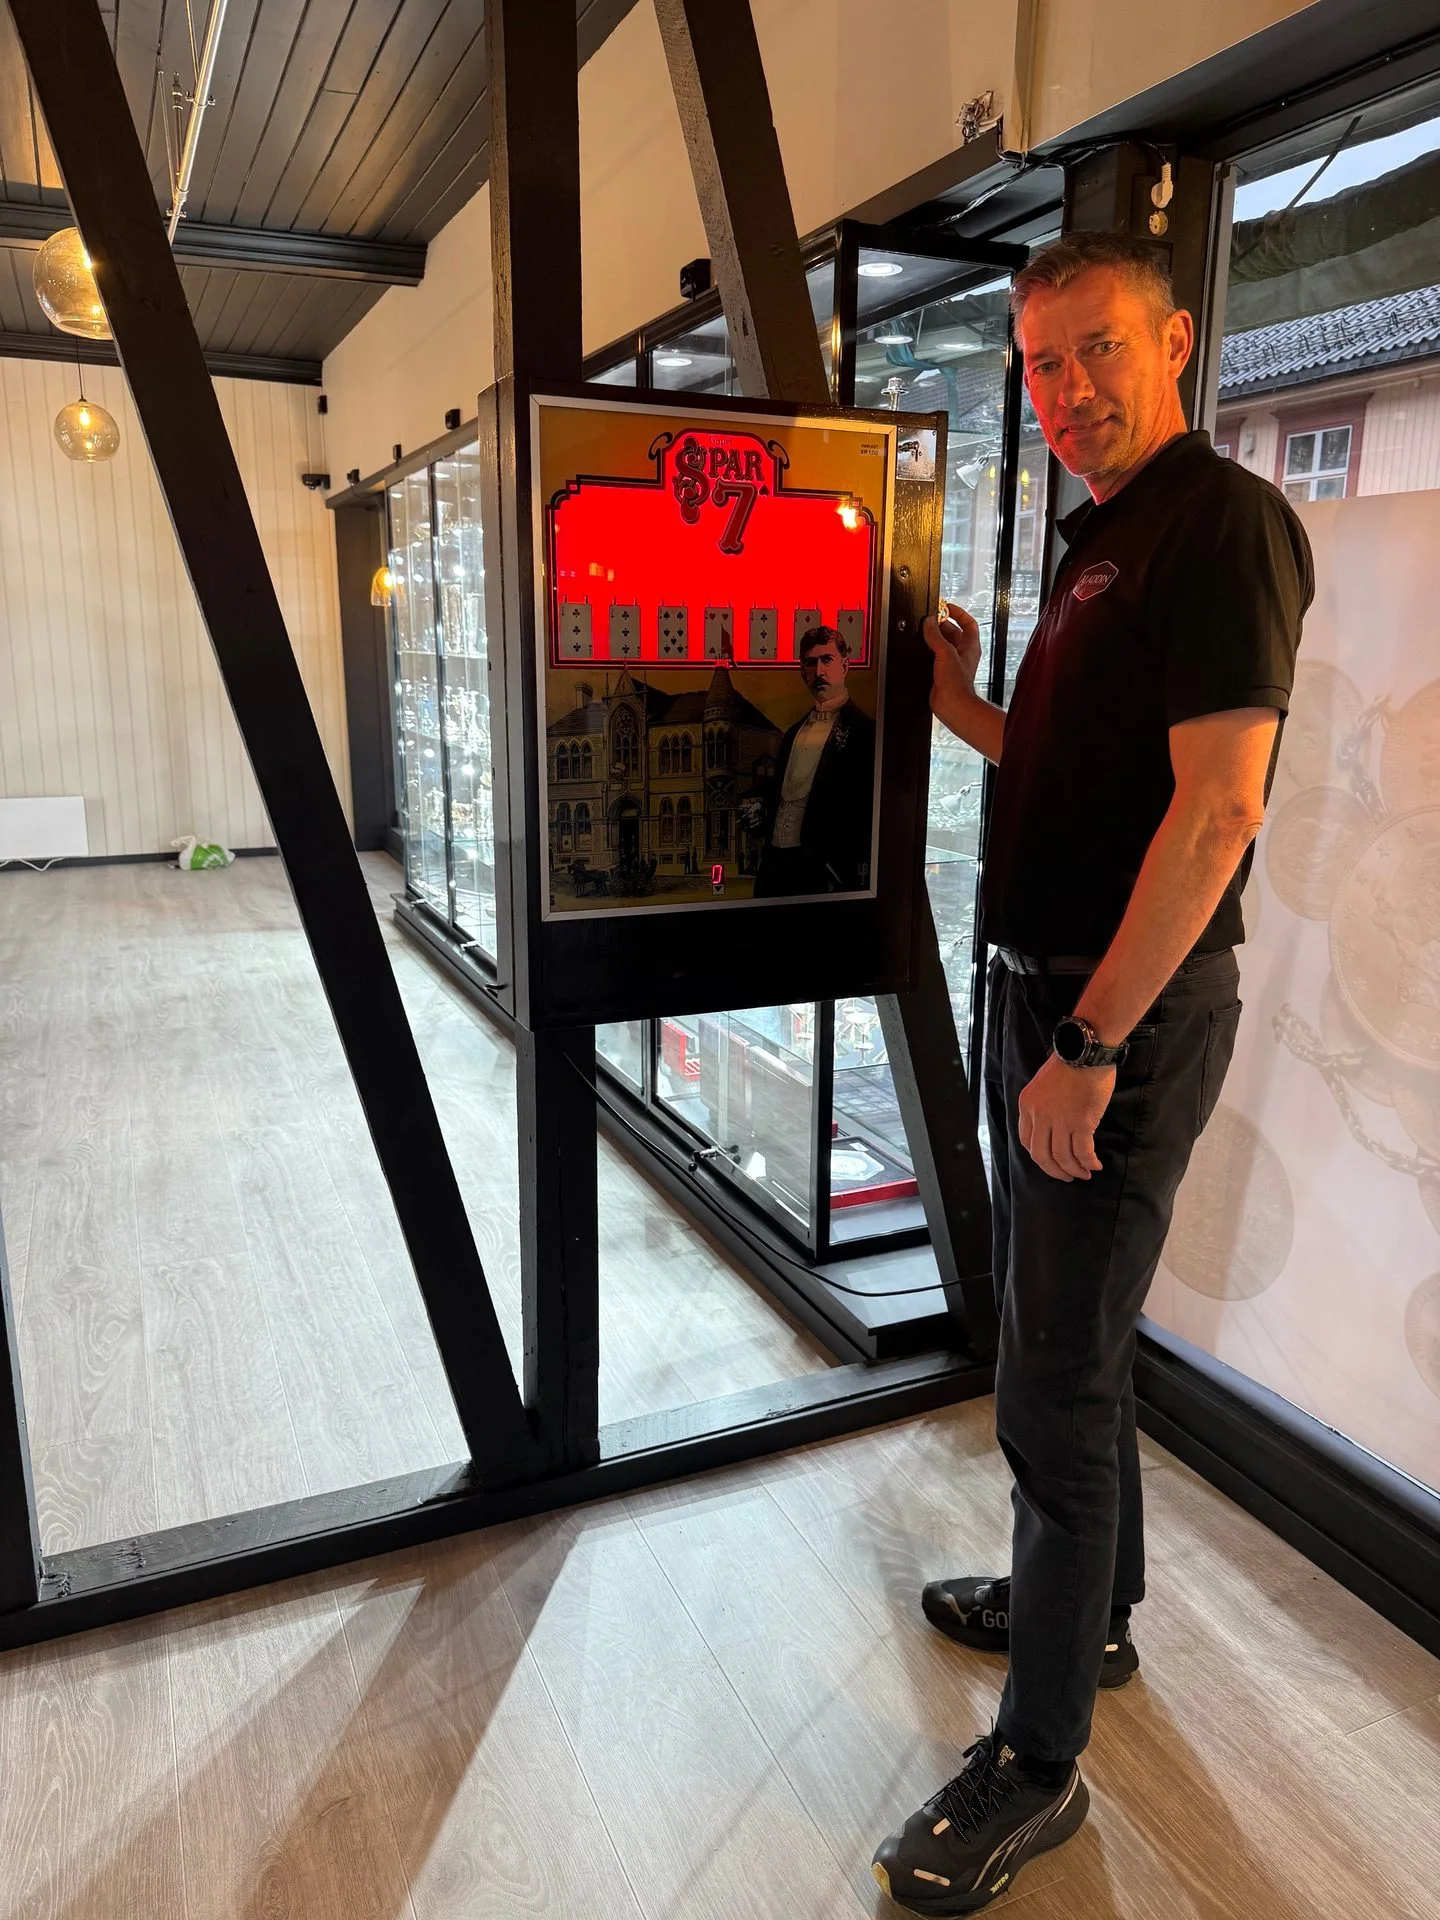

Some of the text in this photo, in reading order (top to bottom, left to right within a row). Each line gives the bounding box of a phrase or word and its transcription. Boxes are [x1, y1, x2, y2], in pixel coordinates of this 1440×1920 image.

[673, 437, 763, 524] SPAR
[711, 480, 758, 555] 7
[982, 1609, 1010, 1629] GO
[989, 1872, 1009, 1894] NITRO
